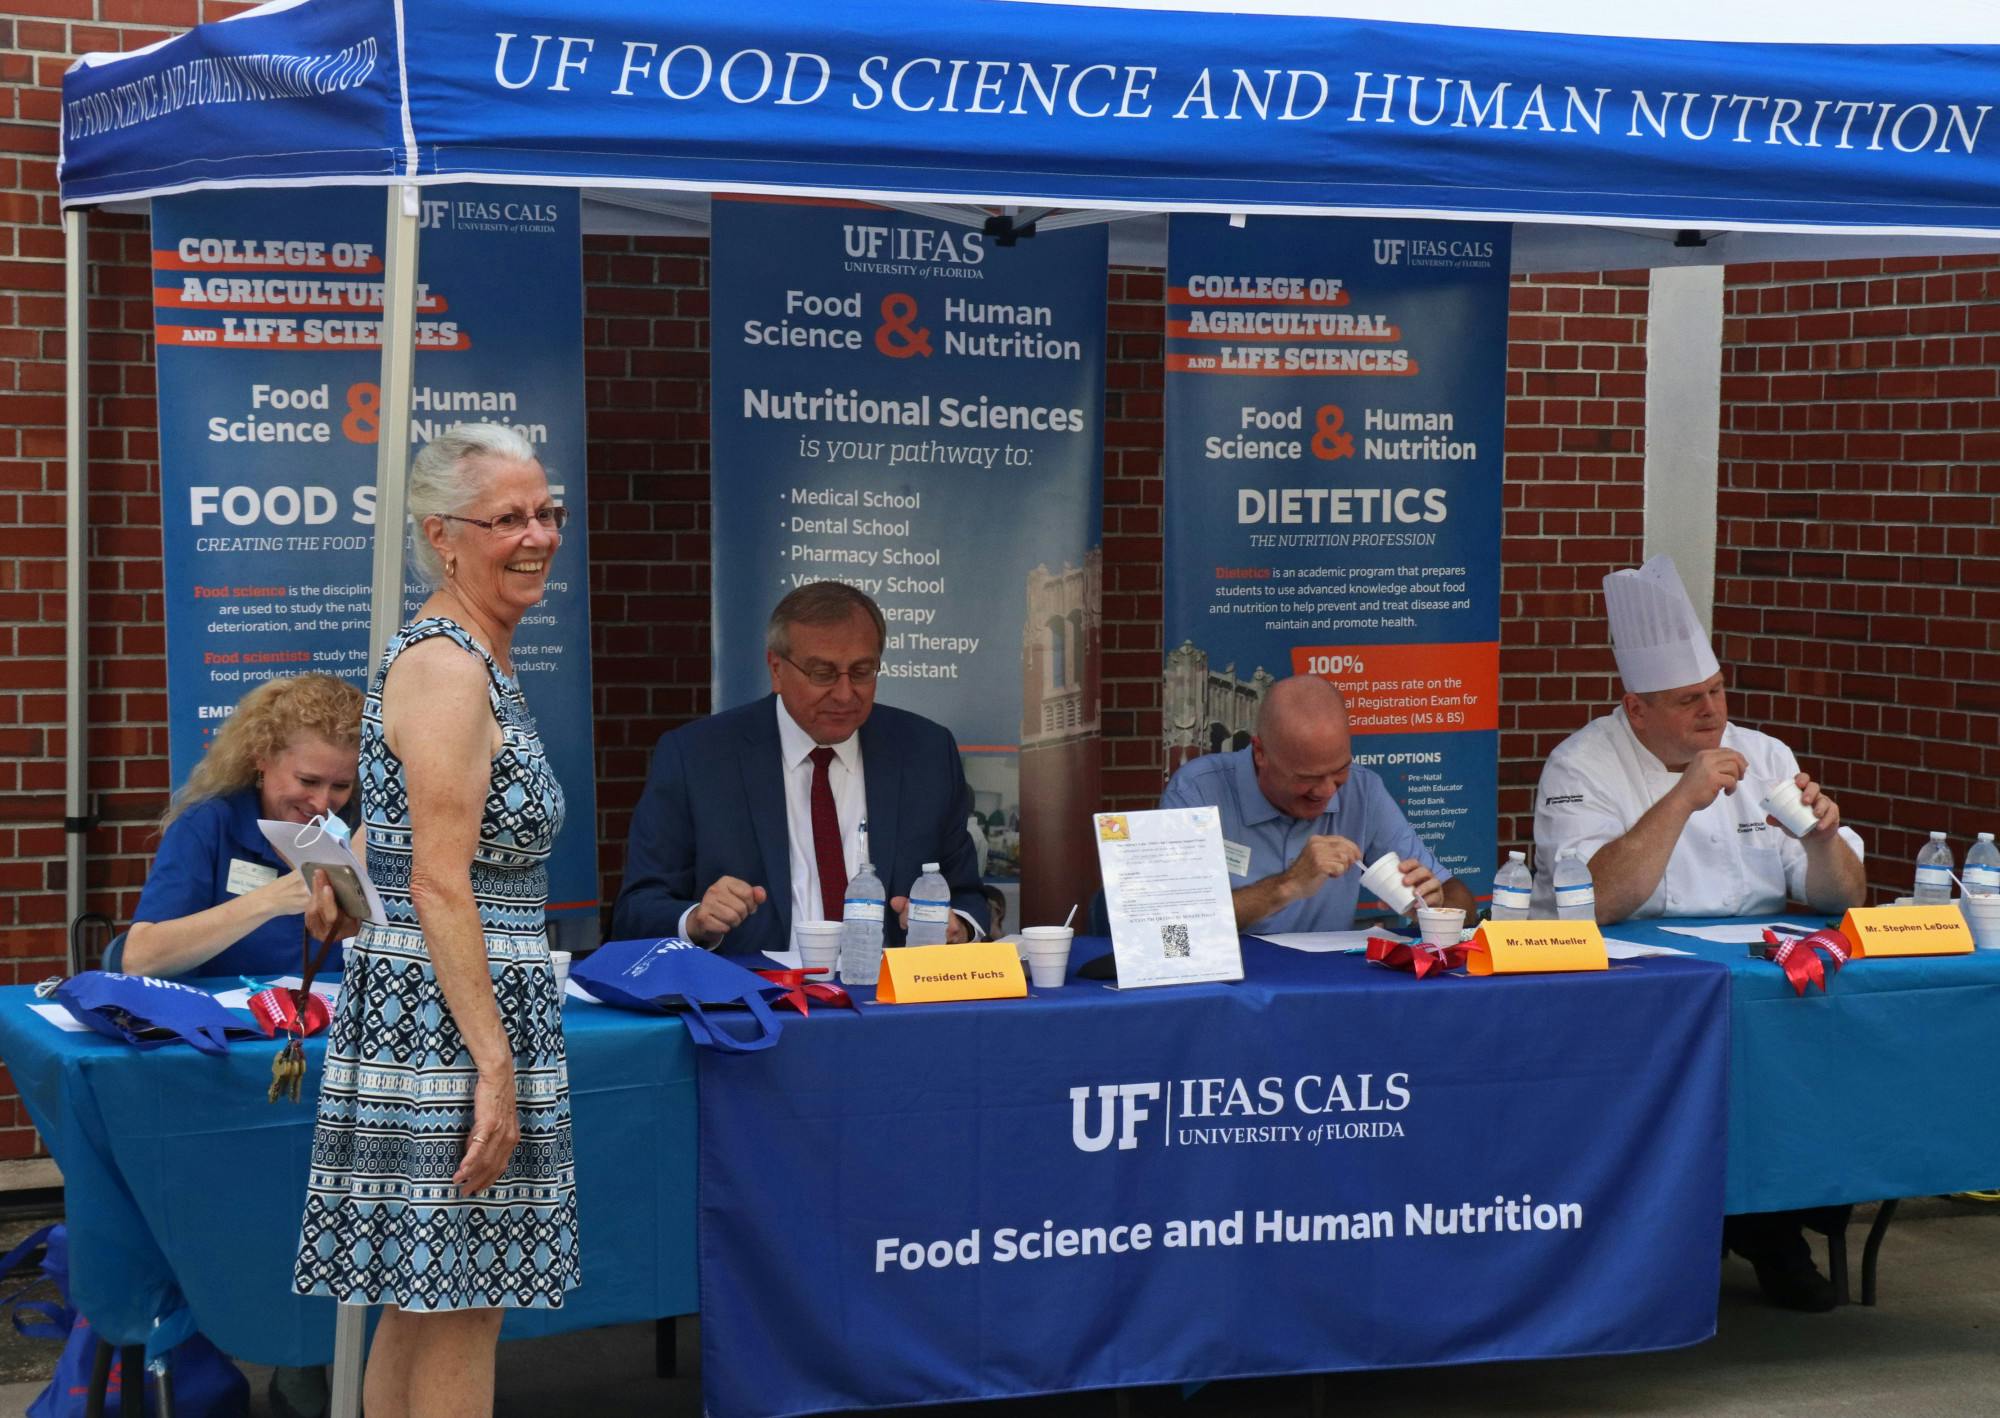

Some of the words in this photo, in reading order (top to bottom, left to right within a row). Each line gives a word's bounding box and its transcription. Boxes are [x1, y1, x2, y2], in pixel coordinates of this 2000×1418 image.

[68, 101, 81, 141] UF
[82, 92, 114, 137] FOOD
[111, 75, 159, 130] SCIENCE
[159, 65, 186, 115] AND
[186, 57, 243, 106] HUMAN
[315, 37, 377, 95] CLUB
[494, 33, 594, 91] UF
[611, 41, 830, 105] FOOD
[852, 55, 1157, 119] SCIENCE
[1173, 68, 1329, 120] AND
[1347, 71, 1612, 134] HUMAN
[1626, 90, 1993, 154] NUTRITION
[458, 201, 501, 220] IFAS
[504, 203, 558, 222] CALS
[458, 223, 509, 231] UNIVERSITY
[520, 224, 555, 233] FLORIDA
[178, 237, 326, 266] COLLEGE
[331, 242, 373, 268] OF
[843, 224, 889, 259] UF
[897, 228, 985, 265] IFAS
[1373, 238, 1406, 265] UF
[1412, 240, 1447, 256] IFAS
[1450, 241, 1494, 258] CALS
[844, 261, 917, 275] UNIVERSITY
[919, 265, 932, 279] of
[933, 266, 984, 280] FLORIDA
[180, 277, 436, 309] AGRICULTURL
[1188, 275, 1304, 300] COLLEGE
[1309, 278, 1343, 301] OF
[786, 289, 862, 318] Food
[945, 297, 1052, 327] Human
[182, 329, 217, 342] AND
[222, 317, 298, 344] LIFE
[303, 318, 459, 347] SCIEES
[743, 319, 862, 350] Science
[875, 292, 934, 359] &
[1187, 311, 1391, 337] AGRICULTURAL
[944, 330, 1081, 361] Nutrition
[1187, 358, 1216, 369] AND
[1221, 347, 1280, 370] LIFE
[1284, 348, 1409, 372] SCIENCES
[252, 384, 329, 410] Food
[412, 386, 517, 412] Human
[341, 382, 381, 446] &
[744, 388, 930, 427] Nutritional
[939, 395, 1084, 433] Sciences
[1241, 405, 1302, 430] Food
[1364, 408, 1454, 431] Human
[208, 415, 331, 443] Science
[1311, 404, 1356, 461] &
[800, 435, 820, 457] is
[826, 438, 885, 463] your
[888, 440, 1000, 469] pathway
[1004, 442, 1034, 466] to:
[1205, 434, 1302, 460] Science
[1364, 435, 1477, 461] Nutrition
[189, 486, 338, 526] FOOD
[791, 488, 859, 507] Medical
[863, 490, 920, 509] School
[1238, 487, 1448, 524] DIETETICS
[791, 516, 848, 535] Dental
[852, 518, 909, 537] School
[196, 537, 283, 552] CREATING
[287, 536, 320, 551] THE
[323, 536, 361, 550] FOOD
[1250, 534, 1276, 547] THE
[1277, 534, 1350, 547] NUTRITION
[1351, 533, 1437, 546] PROFESSION
[791, 545, 878, 566] Pharmacy
[882, 548, 940, 565] School
[1215, 567, 1270, 579] Dietetics
[1297, 566, 1347, 577] academic
[1349, 567, 1395, 579] program
[1397, 565, 1419, 577] that
[1422, 566, 1466, 578] prepares
[193, 585, 229, 598] Food
[233, 585, 287, 598] science
[288, 585, 298, 596] is
[301, 585, 320, 596] the
[887, 577, 944, 594] School
[1215, 585, 1262, 596] students
[1278, 586, 1295, 595] use
[1297, 584, 1347, 595] advanced
[1349, 583, 1407, 596] knowledge
[1409, 582, 1440, 593] about
[1442, 581, 1466, 592] food
[219, 606, 240, 615] are
[242, 603, 272, 615] used
[290, 602, 323, 615] study
[325, 602, 345, 613] the
[1209, 603, 1230, 614] and
[1233, 602, 1278, 613] nutrition
[1293, 601, 1315, 614] help
[1317, 601, 1357, 614] prevent
[1360, 600, 1380, 611] and
[1383, 600, 1409, 610] treat
[1411, 599, 1450, 610] disease
[1452, 598, 1470, 609] and
[207, 621, 292, 633] deterioration,
[294, 620, 317, 631] and
[319, 619, 338, 630] the
[1265, 618, 1309, 630] maintain
[1311, 618, 1331, 629] and
[1333, 617, 1379, 630] promote
[1381, 616, 1418, 628] health.
[541, 644, 563, 654] new
[907, 633, 980, 654] Therapy
[203, 652, 240, 665] Food
[242, 651, 311, 664] scientists
[313, 650, 346, 662] study
[348, 649, 368, 660] the
[1308, 655, 1364, 675] 100%
[210, 669, 239, 681] food
[334, 667, 368, 678] world
[877, 661, 958, 679] Assistant
[1372, 681, 1399, 692] pass
[1401, 679, 1425, 689] rate
[1444, 677, 1462, 688] the
[1358, 695, 1428, 710] Registration
[1431, 694, 1460, 706] Exam
[1463, 693, 1478, 705] for
[1348, 714, 1408, 726] Graduates
[1411, 712, 1433, 726] (MS
[1447, 711, 1465, 724] BS)
[1388, 752, 1442, 765] OPTIONS
[1408, 784, 1431, 793] Health
[1433, 784, 1464, 792] Educator
[1408, 808, 1440, 817] Nutrition
[1441, 807, 1468, 815] Director
[1440, 855, 1468, 864] Industry
[1864, 925, 1881, 933] Mr.
[1883, 924, 1922, 933] Stephen
[1924, 922, 1961, 931] LeDoux
[1506, 938, 1523, 947] Mr.
[1525, 938, 1549, 946] Matt
[1550, 937, 1587, 946] Mueller
[913, 971, 968, 983] President
[970, 970, 1005, 980] Fuchs
[1069, 1081, 1161, 1153] UF
[1179, 1077, 1284, 1119] IFAS
[1293, 1072, 1412, 1116] CALS
[1178, 1124, 1303, 1146] UNIVERSITY
[1307, 1122, 1326, 1145] of
[1326, 1120, 1406, 1141] FLORIDA
[874, 1230, 981, 1274] Food
[992, 1219, 1152, 1263] Science
[1162, 1209, 1246, 1249] and
[1255, 1201, 1395, 1245] Human
[1404, 1193, 1583, 1237] Nutrition
